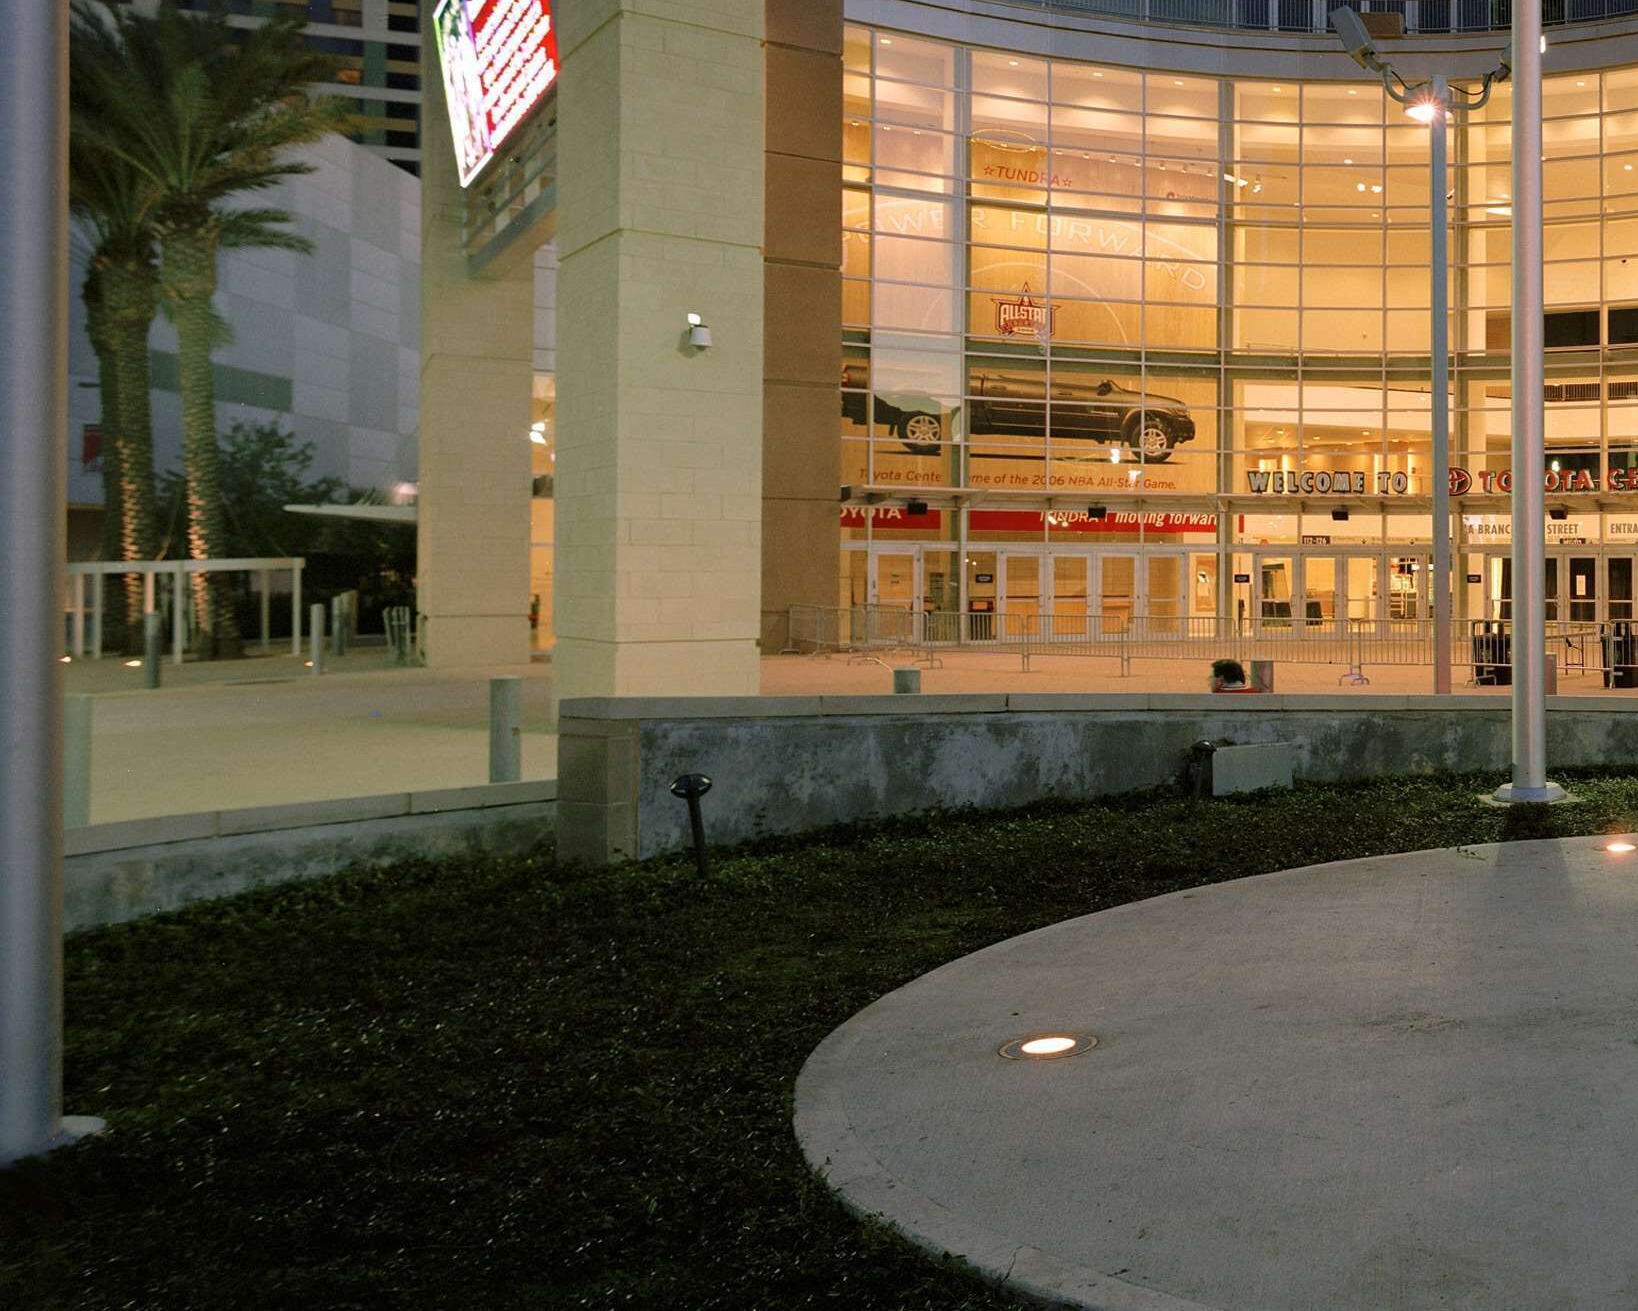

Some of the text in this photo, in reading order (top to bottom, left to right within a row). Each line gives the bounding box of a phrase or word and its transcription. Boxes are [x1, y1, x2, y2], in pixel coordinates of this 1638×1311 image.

[996, 165, 1060, 187] TUNDRA
[842, 209, 988, 243] OWER
[859, 468, 901, 482] Tyota
[905, 470, 944, 483] Cente
[993, 473, 1007, 485] of
[1009, 474, 1029, 486] the
[1031, 474, 1065, 486] 2006
[1068, 475, 1094, 487] NBA
[1143, 478, 1177, 490] Game.
[1248, 471, 1365, 494] WELCOME
[1378, 471, 1408, 494] TO
[1478, 469, 1595, 494] TOOTA
[840, 506, 902, 519] OYOTA
[1169, 513, 1217, 526] forwar
[1478, 523, 1511, 535] BRANC
[1546, 523, 1579, 535] STREET
